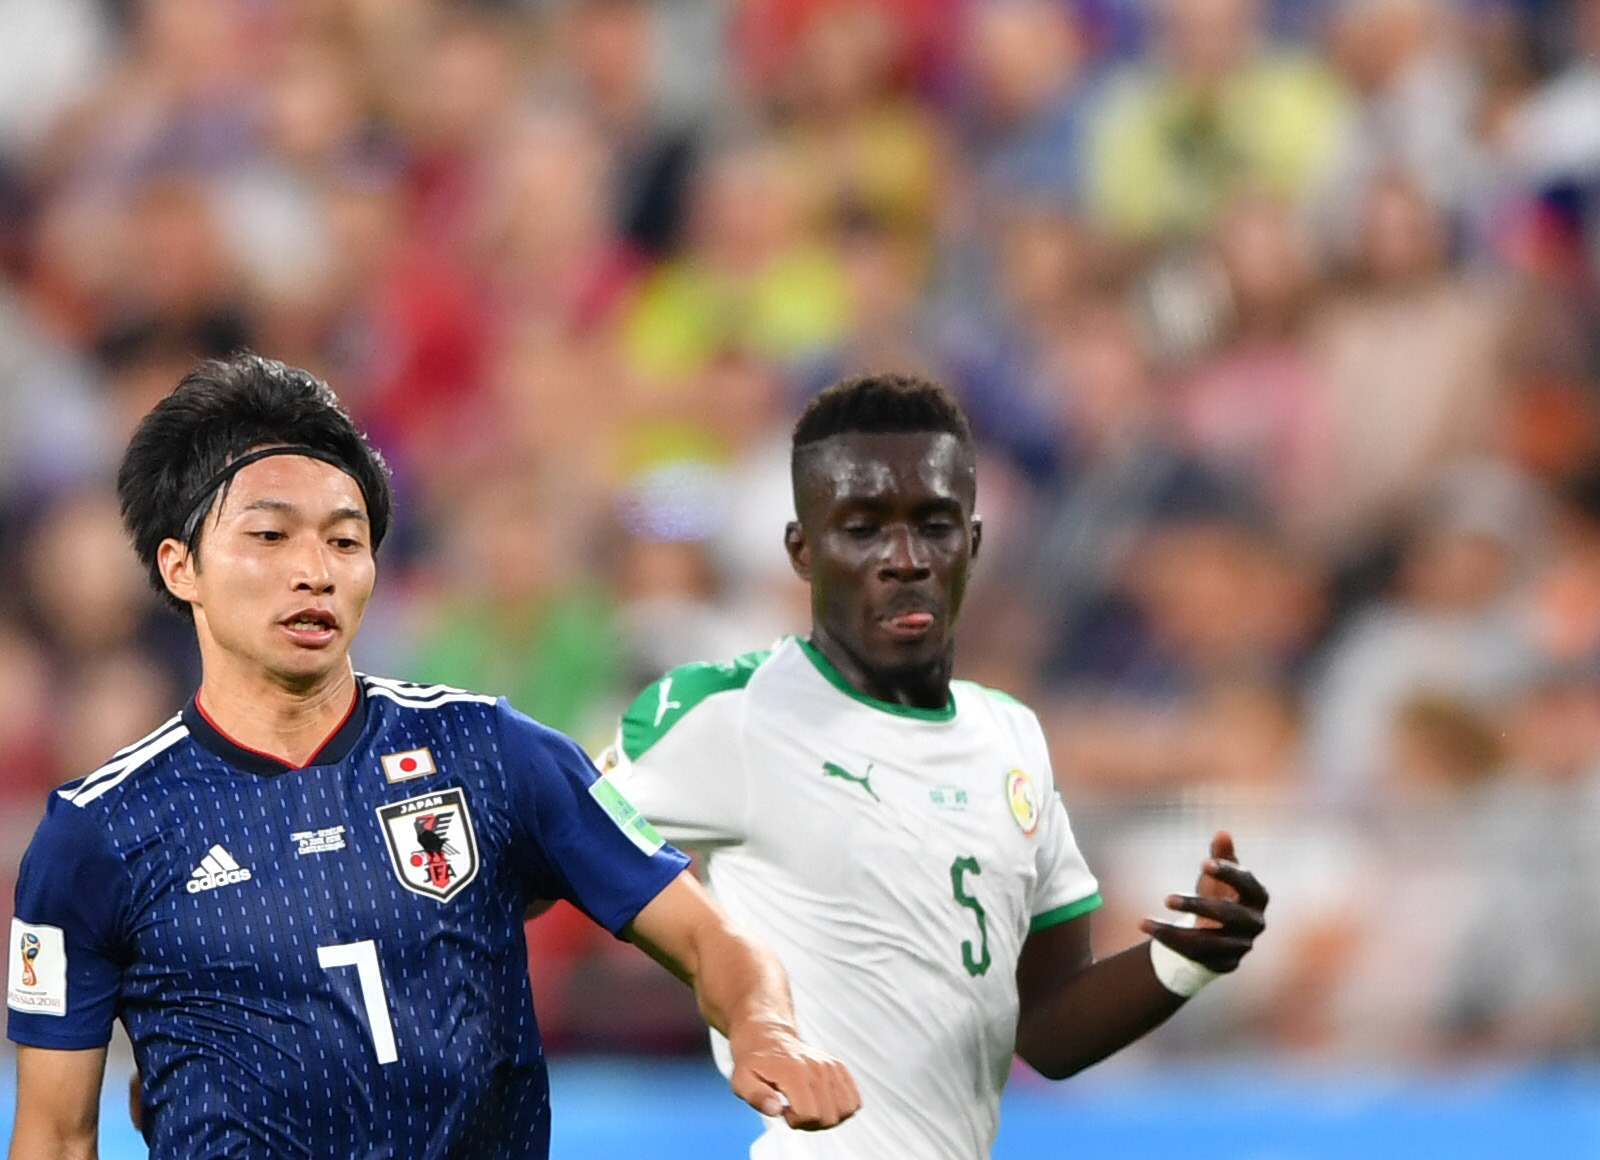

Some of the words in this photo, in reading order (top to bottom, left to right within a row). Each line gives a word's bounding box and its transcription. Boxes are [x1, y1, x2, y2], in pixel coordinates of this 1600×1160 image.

[400, 796, 443, 815] JAPAN
[186, 868, 252, 894] adidas
[423, 863, 458, 884] JFA
[950, 855, 992, 977] 5
[316, 939, 399, 1065] 7
